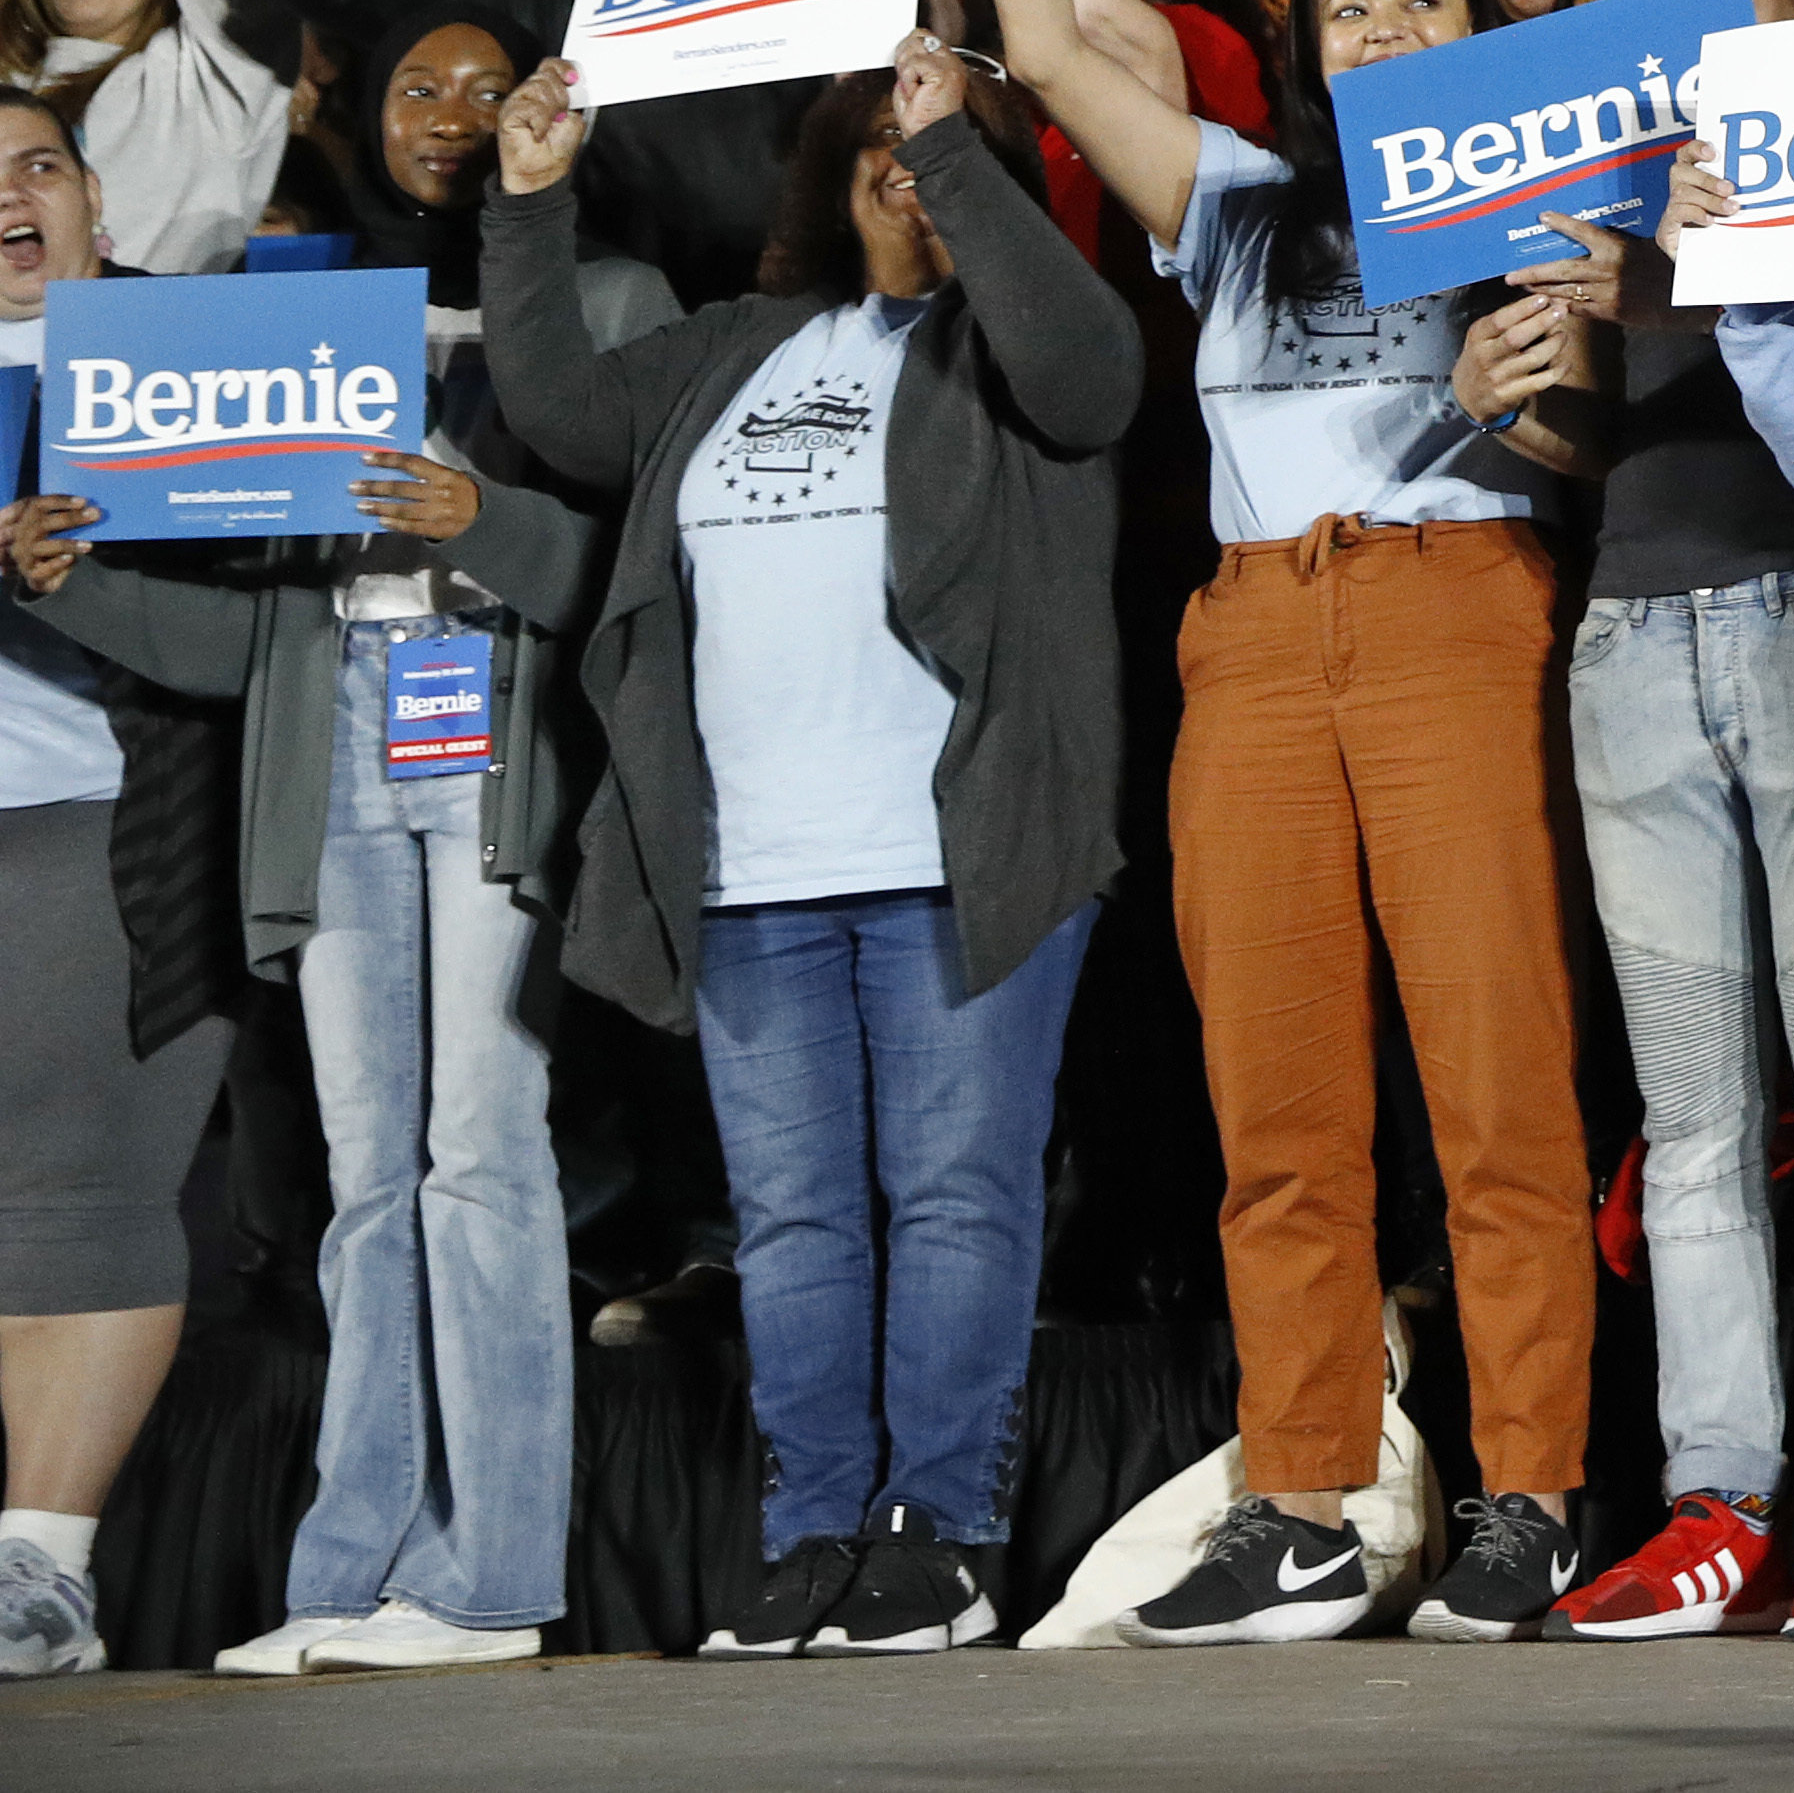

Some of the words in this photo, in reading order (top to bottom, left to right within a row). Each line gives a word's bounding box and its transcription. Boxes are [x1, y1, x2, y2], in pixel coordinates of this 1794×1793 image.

[66, 342, 399, 441] Bernie
[731, 429, 850, 455] ACTION
[395, 689, 482, 716] Bernie
